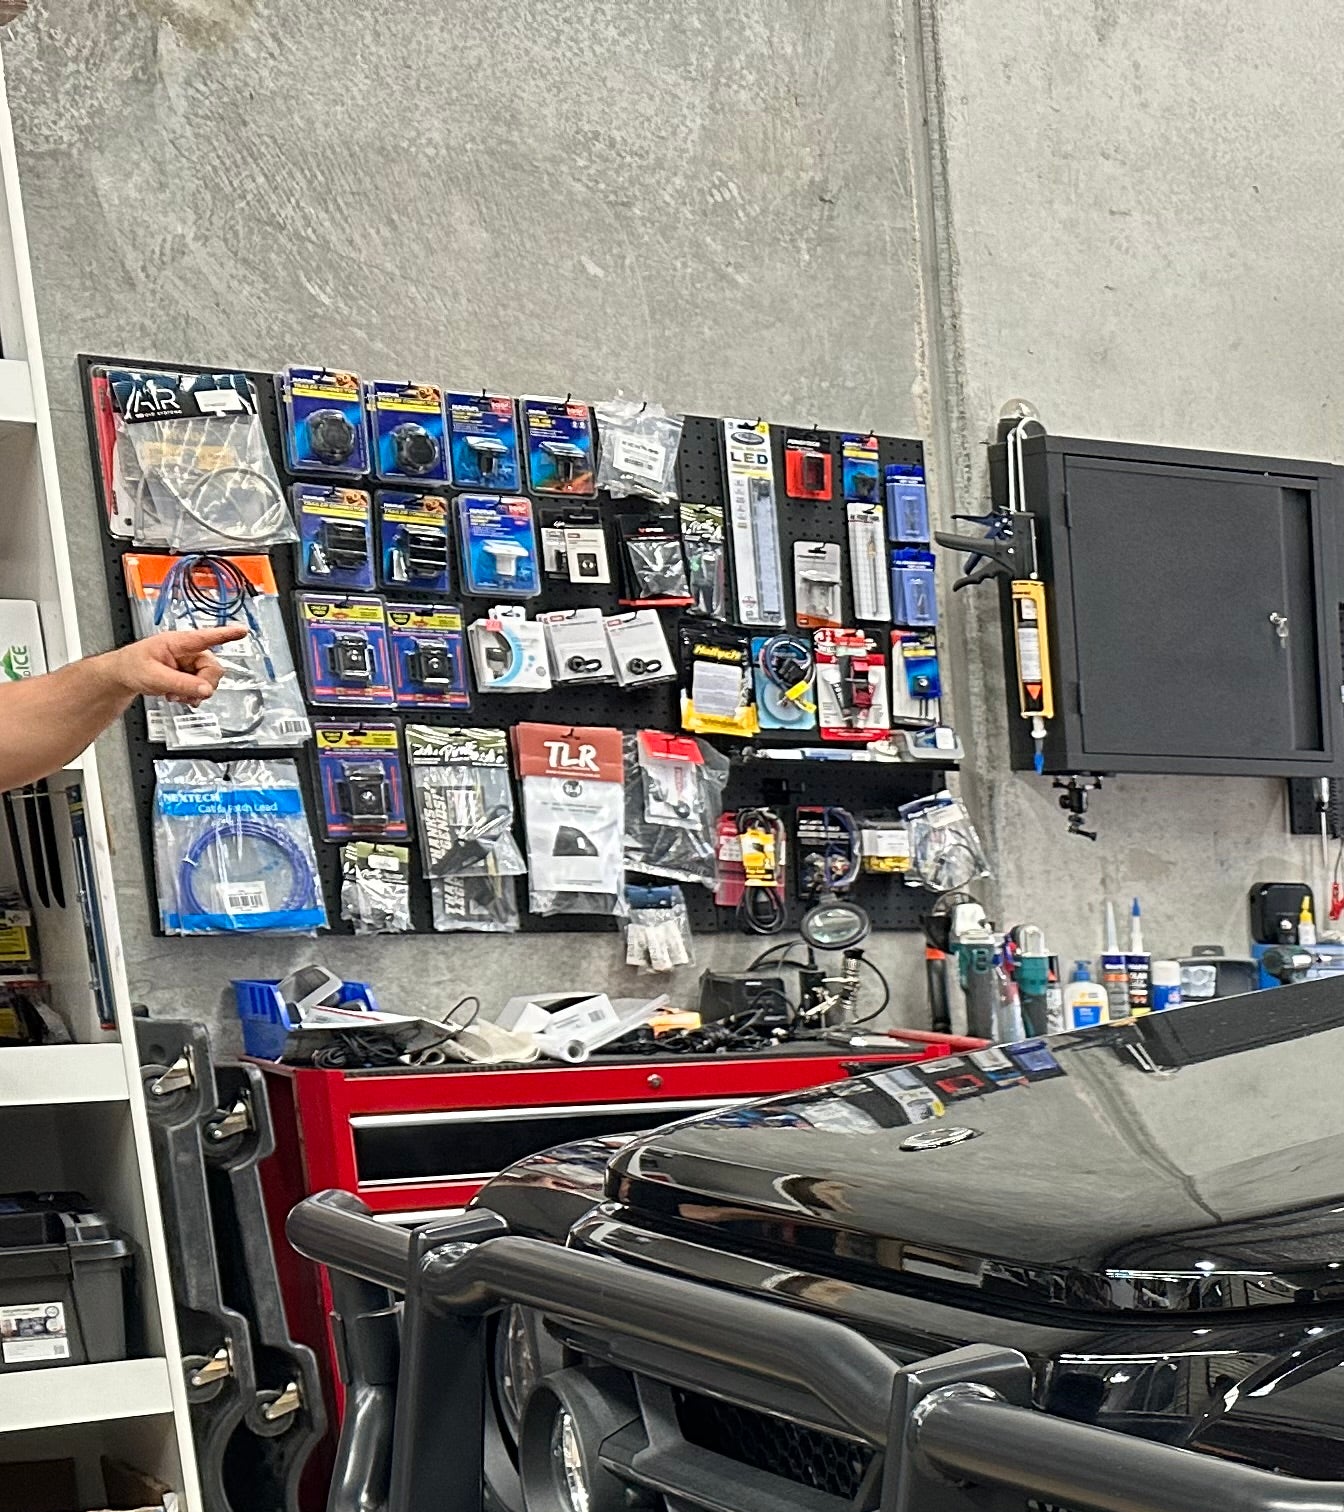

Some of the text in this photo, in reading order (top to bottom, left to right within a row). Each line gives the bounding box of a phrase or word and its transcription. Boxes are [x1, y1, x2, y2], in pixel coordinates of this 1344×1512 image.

[730, 452, 768, 465] LED
[544, 741, 599, 771] TLR
[163, 793, 220, 803] NEXTECH
[254, 803, 278, 812] Lead
